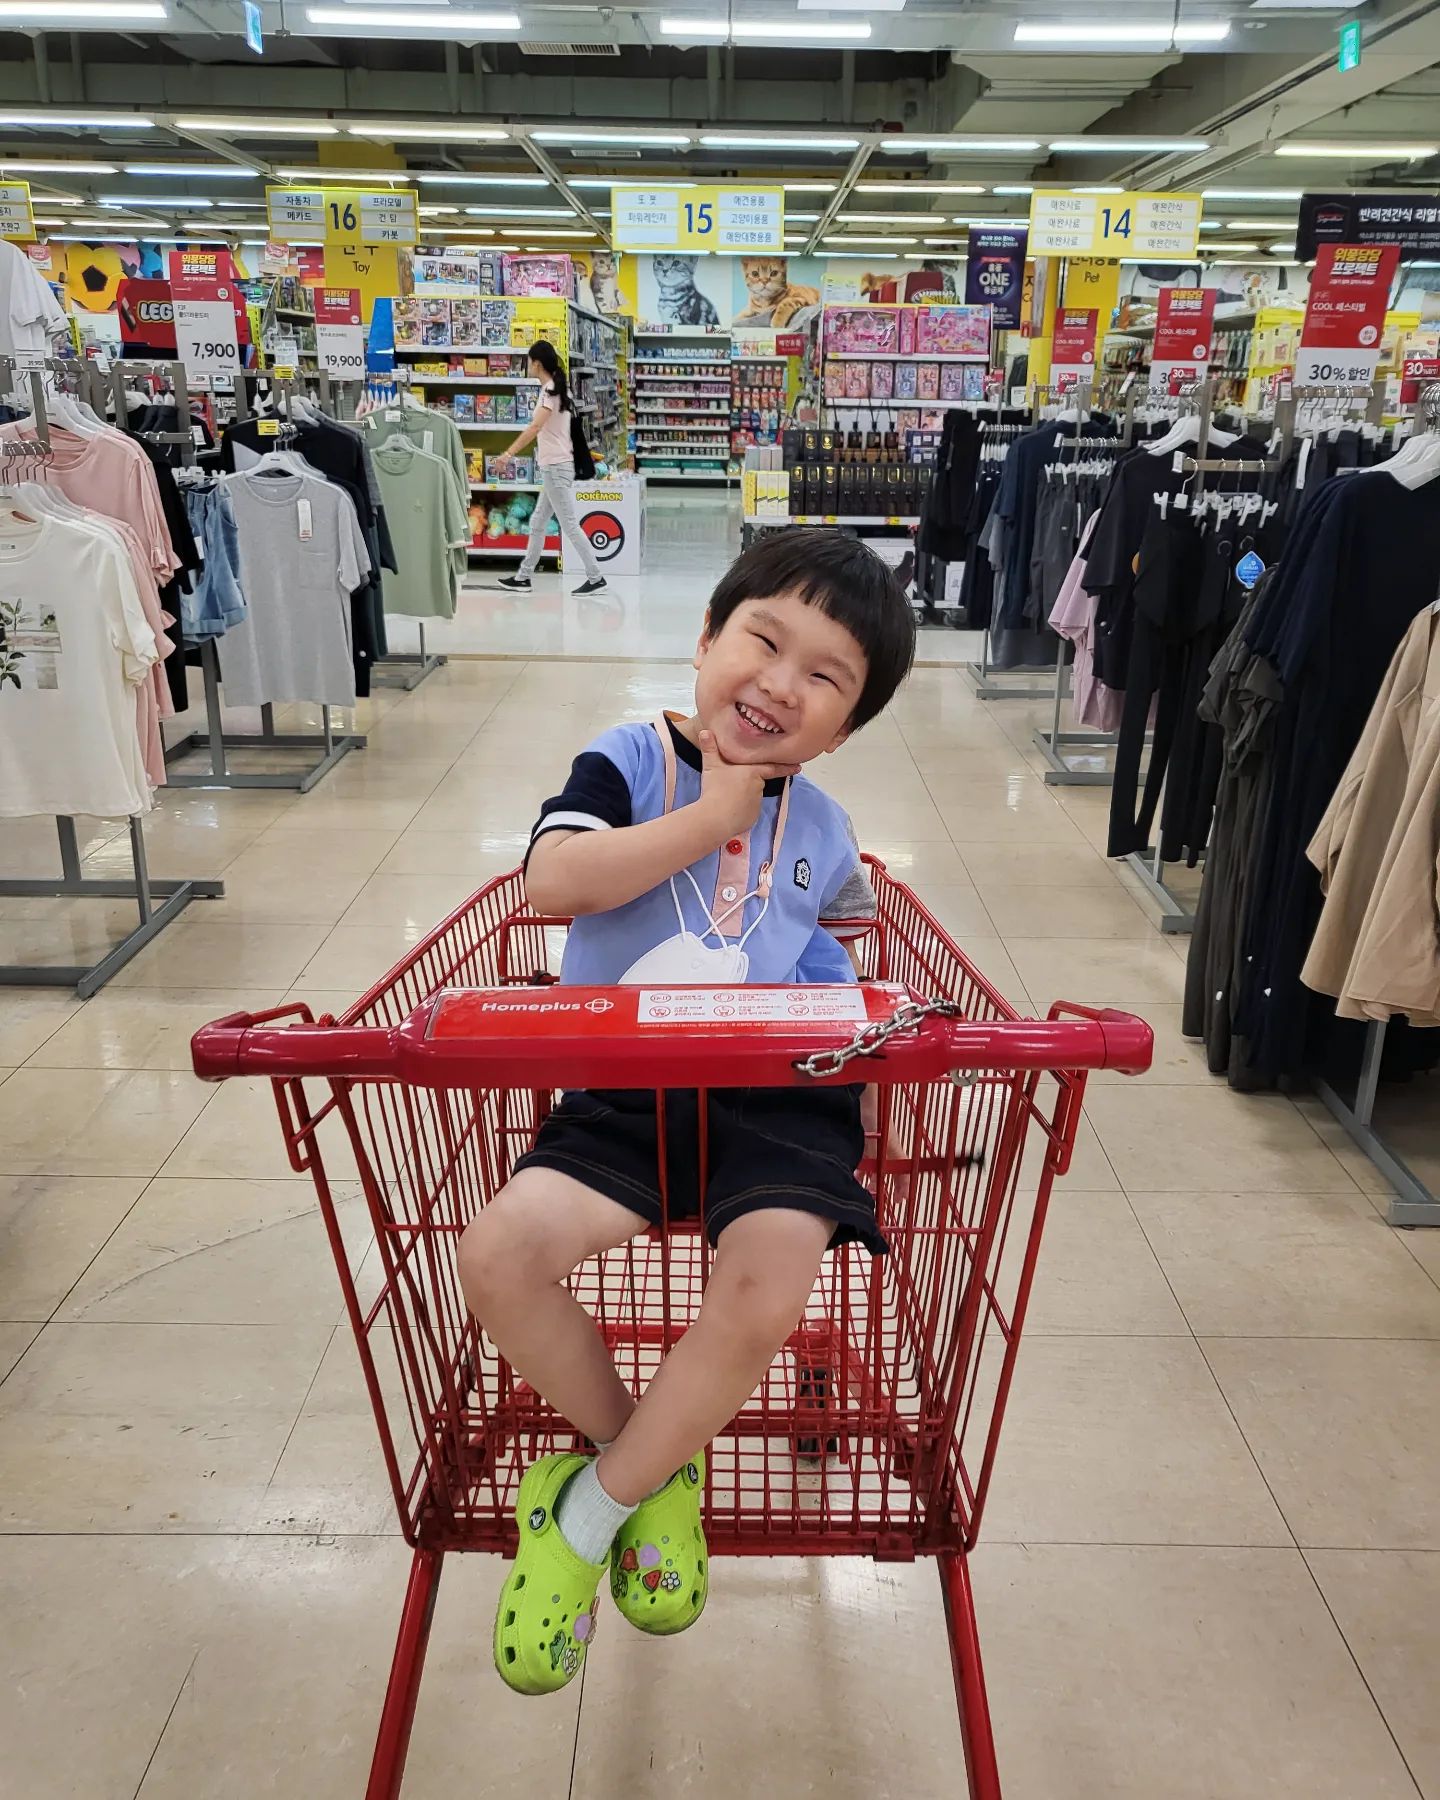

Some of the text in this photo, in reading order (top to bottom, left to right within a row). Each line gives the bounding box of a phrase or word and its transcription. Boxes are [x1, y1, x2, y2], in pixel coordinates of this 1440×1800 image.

[285, 195, 311, 206] 자동차
[373, 197, 402, 208] 프라모델
[733, 195, 765, 206] 애견용품
[1050, 199, 1081, 211] 애완사료
[1152, 201, 1183, 213] 애완간식
[287, 212, 313, 222] 메카드
[329, 203, 357, 231] 16
[628, 213, 667, 225] 파워레인저
[684, 203, 713, 234] 15
[730, 213, 769, 225] 고양이용품
[1359, 208, 1440, 222] 반려견간식 리얼
[1048, 217, 1080, 229] 애완사료
[1102, 208, 1131, 239] 14
[1150, 219, 1183, 231] 애완간식
[726, 231, 772, 243] 애완대형용품
[1046, 236, 1079, 247] 애완사료
[1147, 238, 1180, 249] 애완간식
[182, 254, 217, 265] 위풍당당
[1335, 248, 1382, 262] 위풍당당
[181, 265, 217, 274] 프로젝트
[353, 260, 371, 275] Toy
[1330, 262, 1378, 276] 프로젝트
[979, 272, 1010, 286] ONE
[1084, 271, 1101, 283] Pet
[138, 301, 174, 321] LEG
[1312, 302, 1367, 312] COOL 페스티벌
[192, 342, 236, 359] 7,900
[325, 354, 362, 368] 19,900
[1309, 364, 1371, 381] 30% 할인
[576, 490, 623, 501] POKÉMON
[481, 1001, 581, 1013] Homeplus
